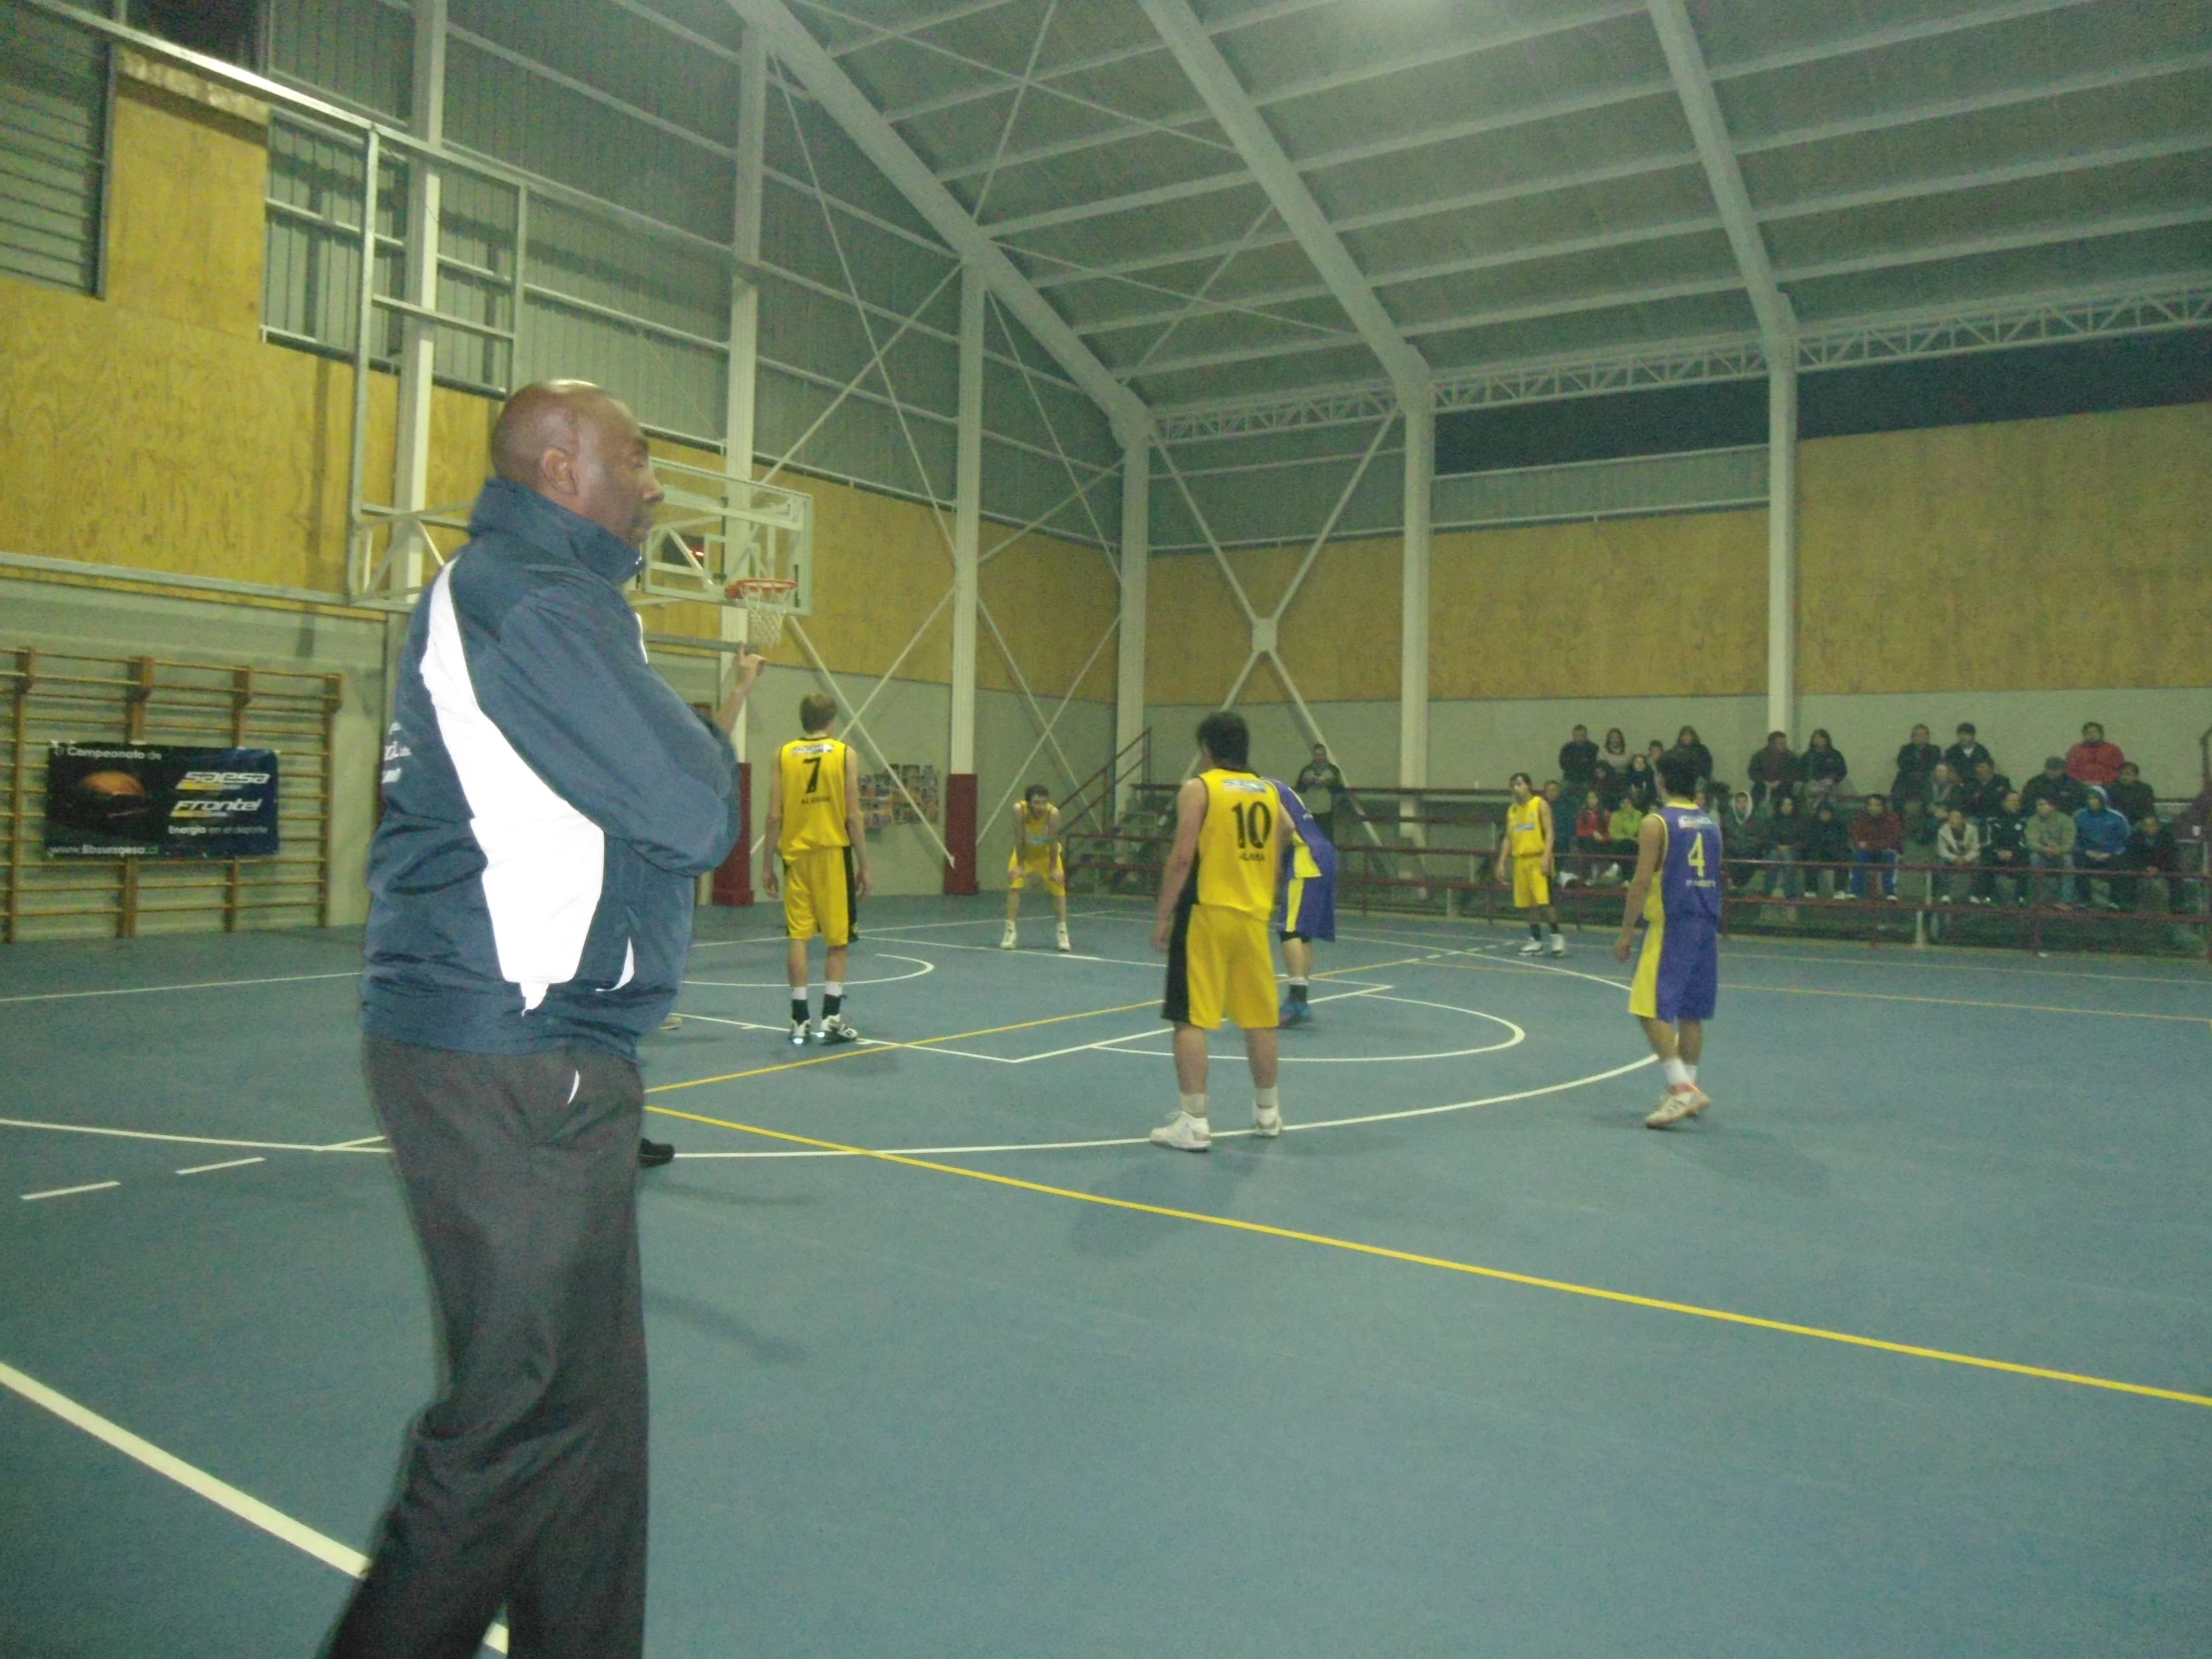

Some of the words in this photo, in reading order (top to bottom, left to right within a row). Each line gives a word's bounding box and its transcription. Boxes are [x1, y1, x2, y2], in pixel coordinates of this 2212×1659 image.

[67, 747, 145, 759] Campeonato
[147, 750, 162, 760] de
[185, 772, 271, 784] saesa
[803, 757, 821, 795] 7
[174, 799, 263, 811] Frontel
[1231, 801, 1272, 849] 10
[1687, 830, 1705, 877] 4
